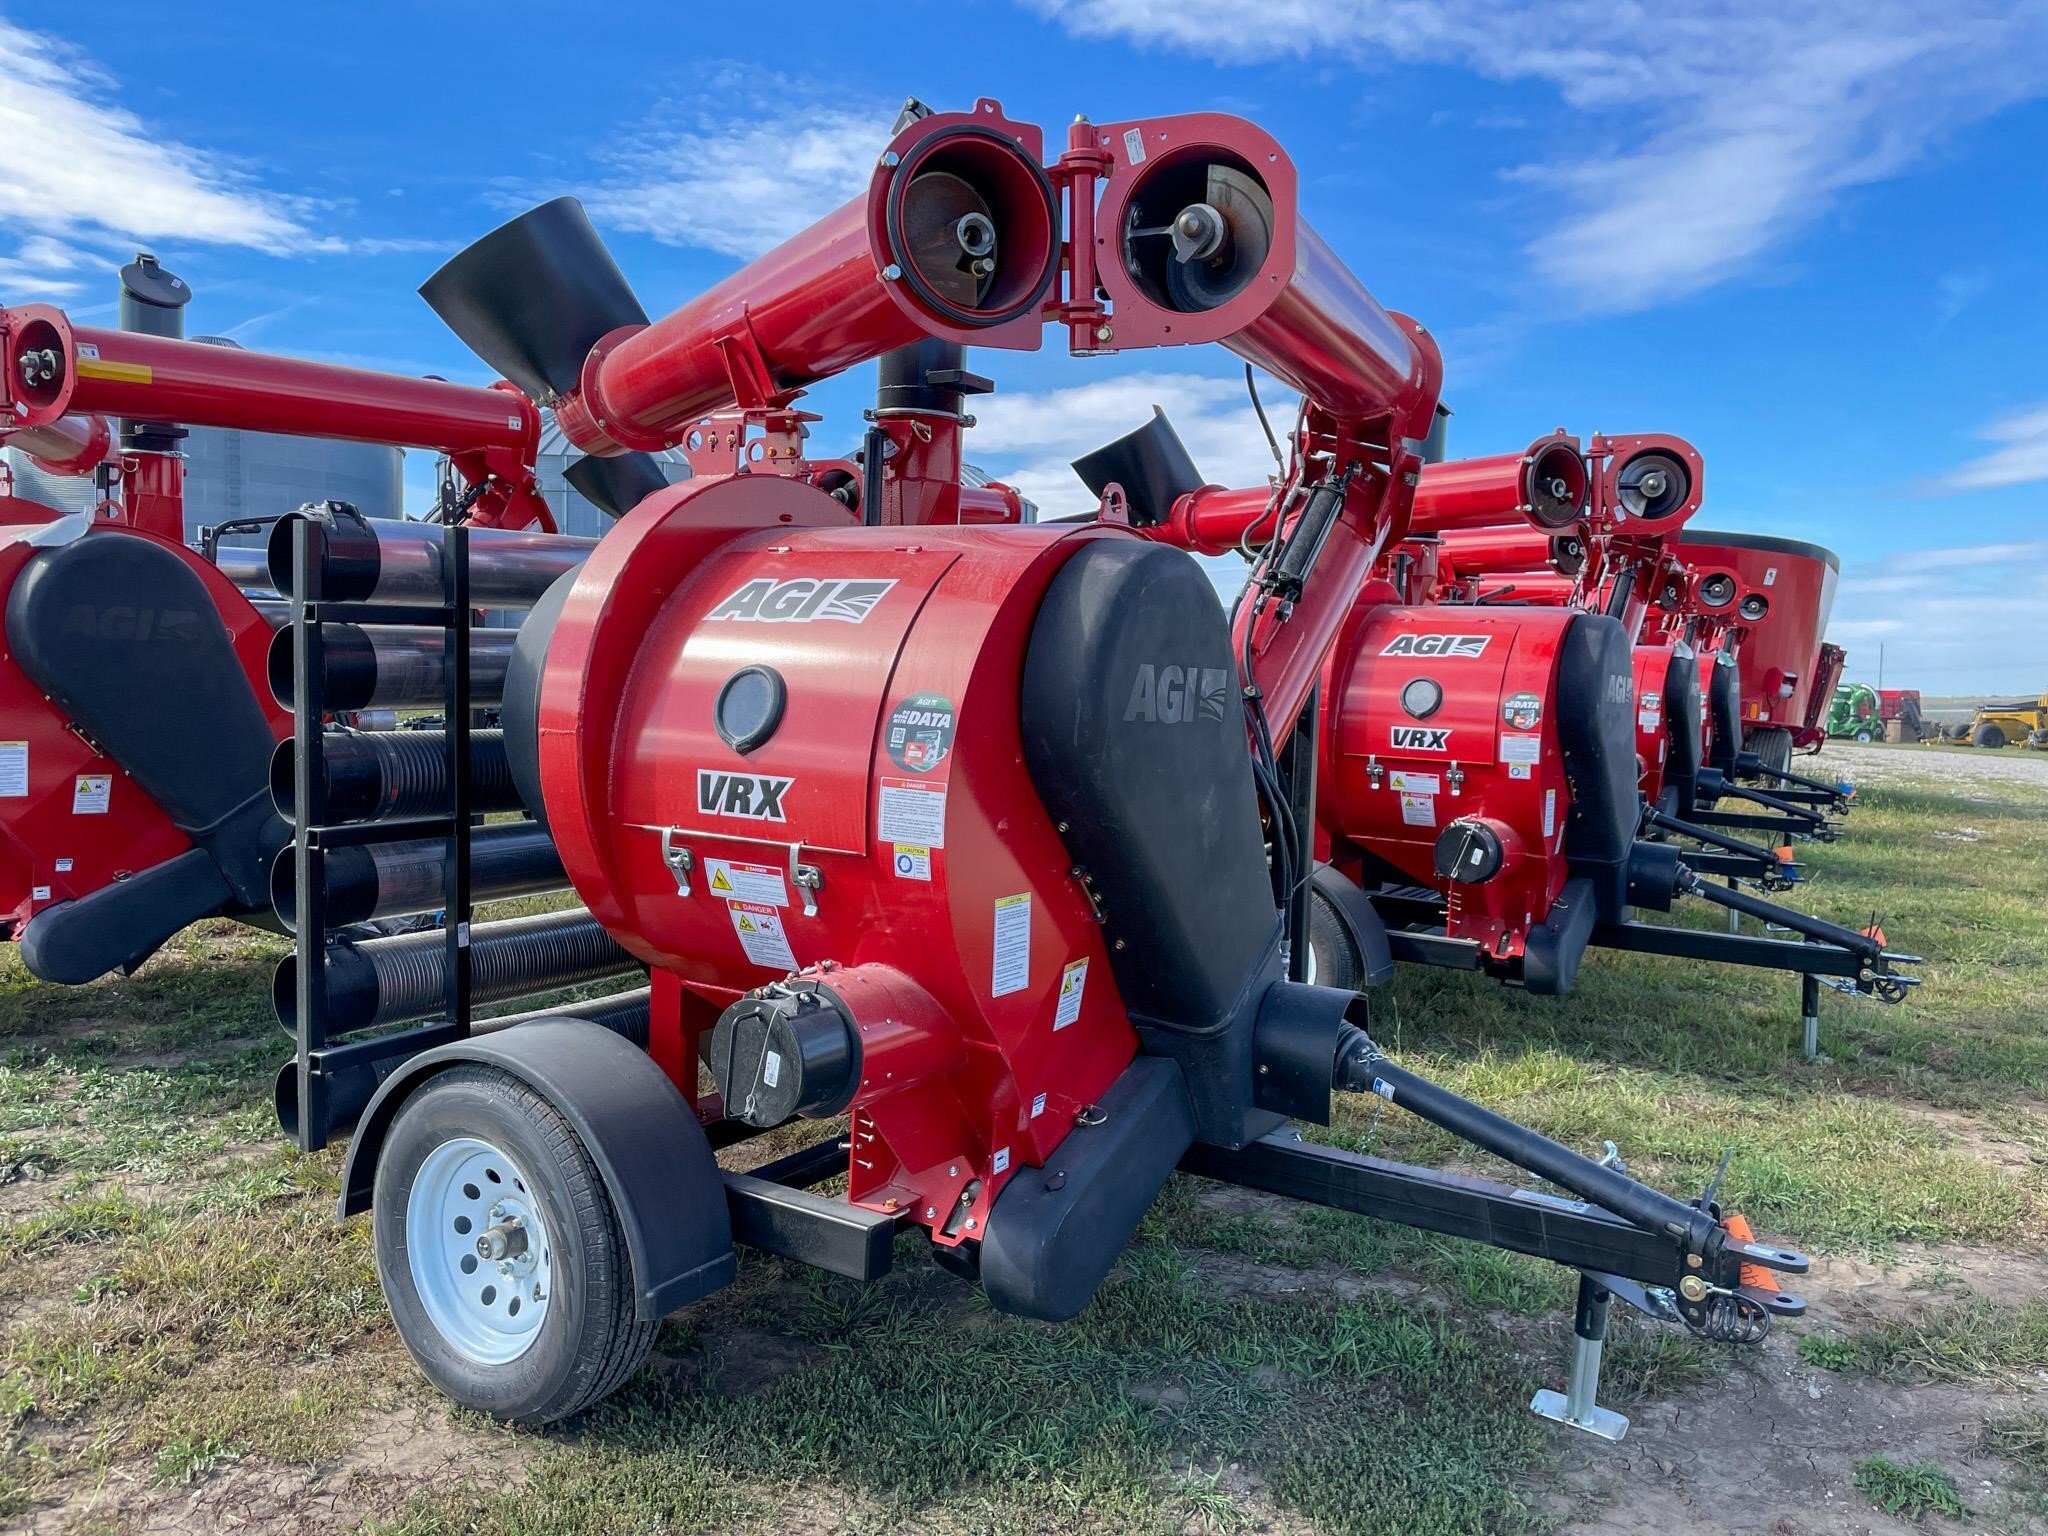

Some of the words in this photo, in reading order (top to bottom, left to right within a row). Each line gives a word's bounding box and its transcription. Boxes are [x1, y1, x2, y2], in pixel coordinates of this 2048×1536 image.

[709, 580, 834, 621] AGI
[1383, 635, 1457, 655] AGI
[916, 698, 932, 706] AGI
[1122, 663, 1198, 724] AGI
[1513, 701, 1540, 709] DATA
[906, 710, 952, 728] DATA
[1393, 728, 1449, 749] VRX
[699, 773, 790, 819] VRX
[742, 903, 772, 914] DANGER
